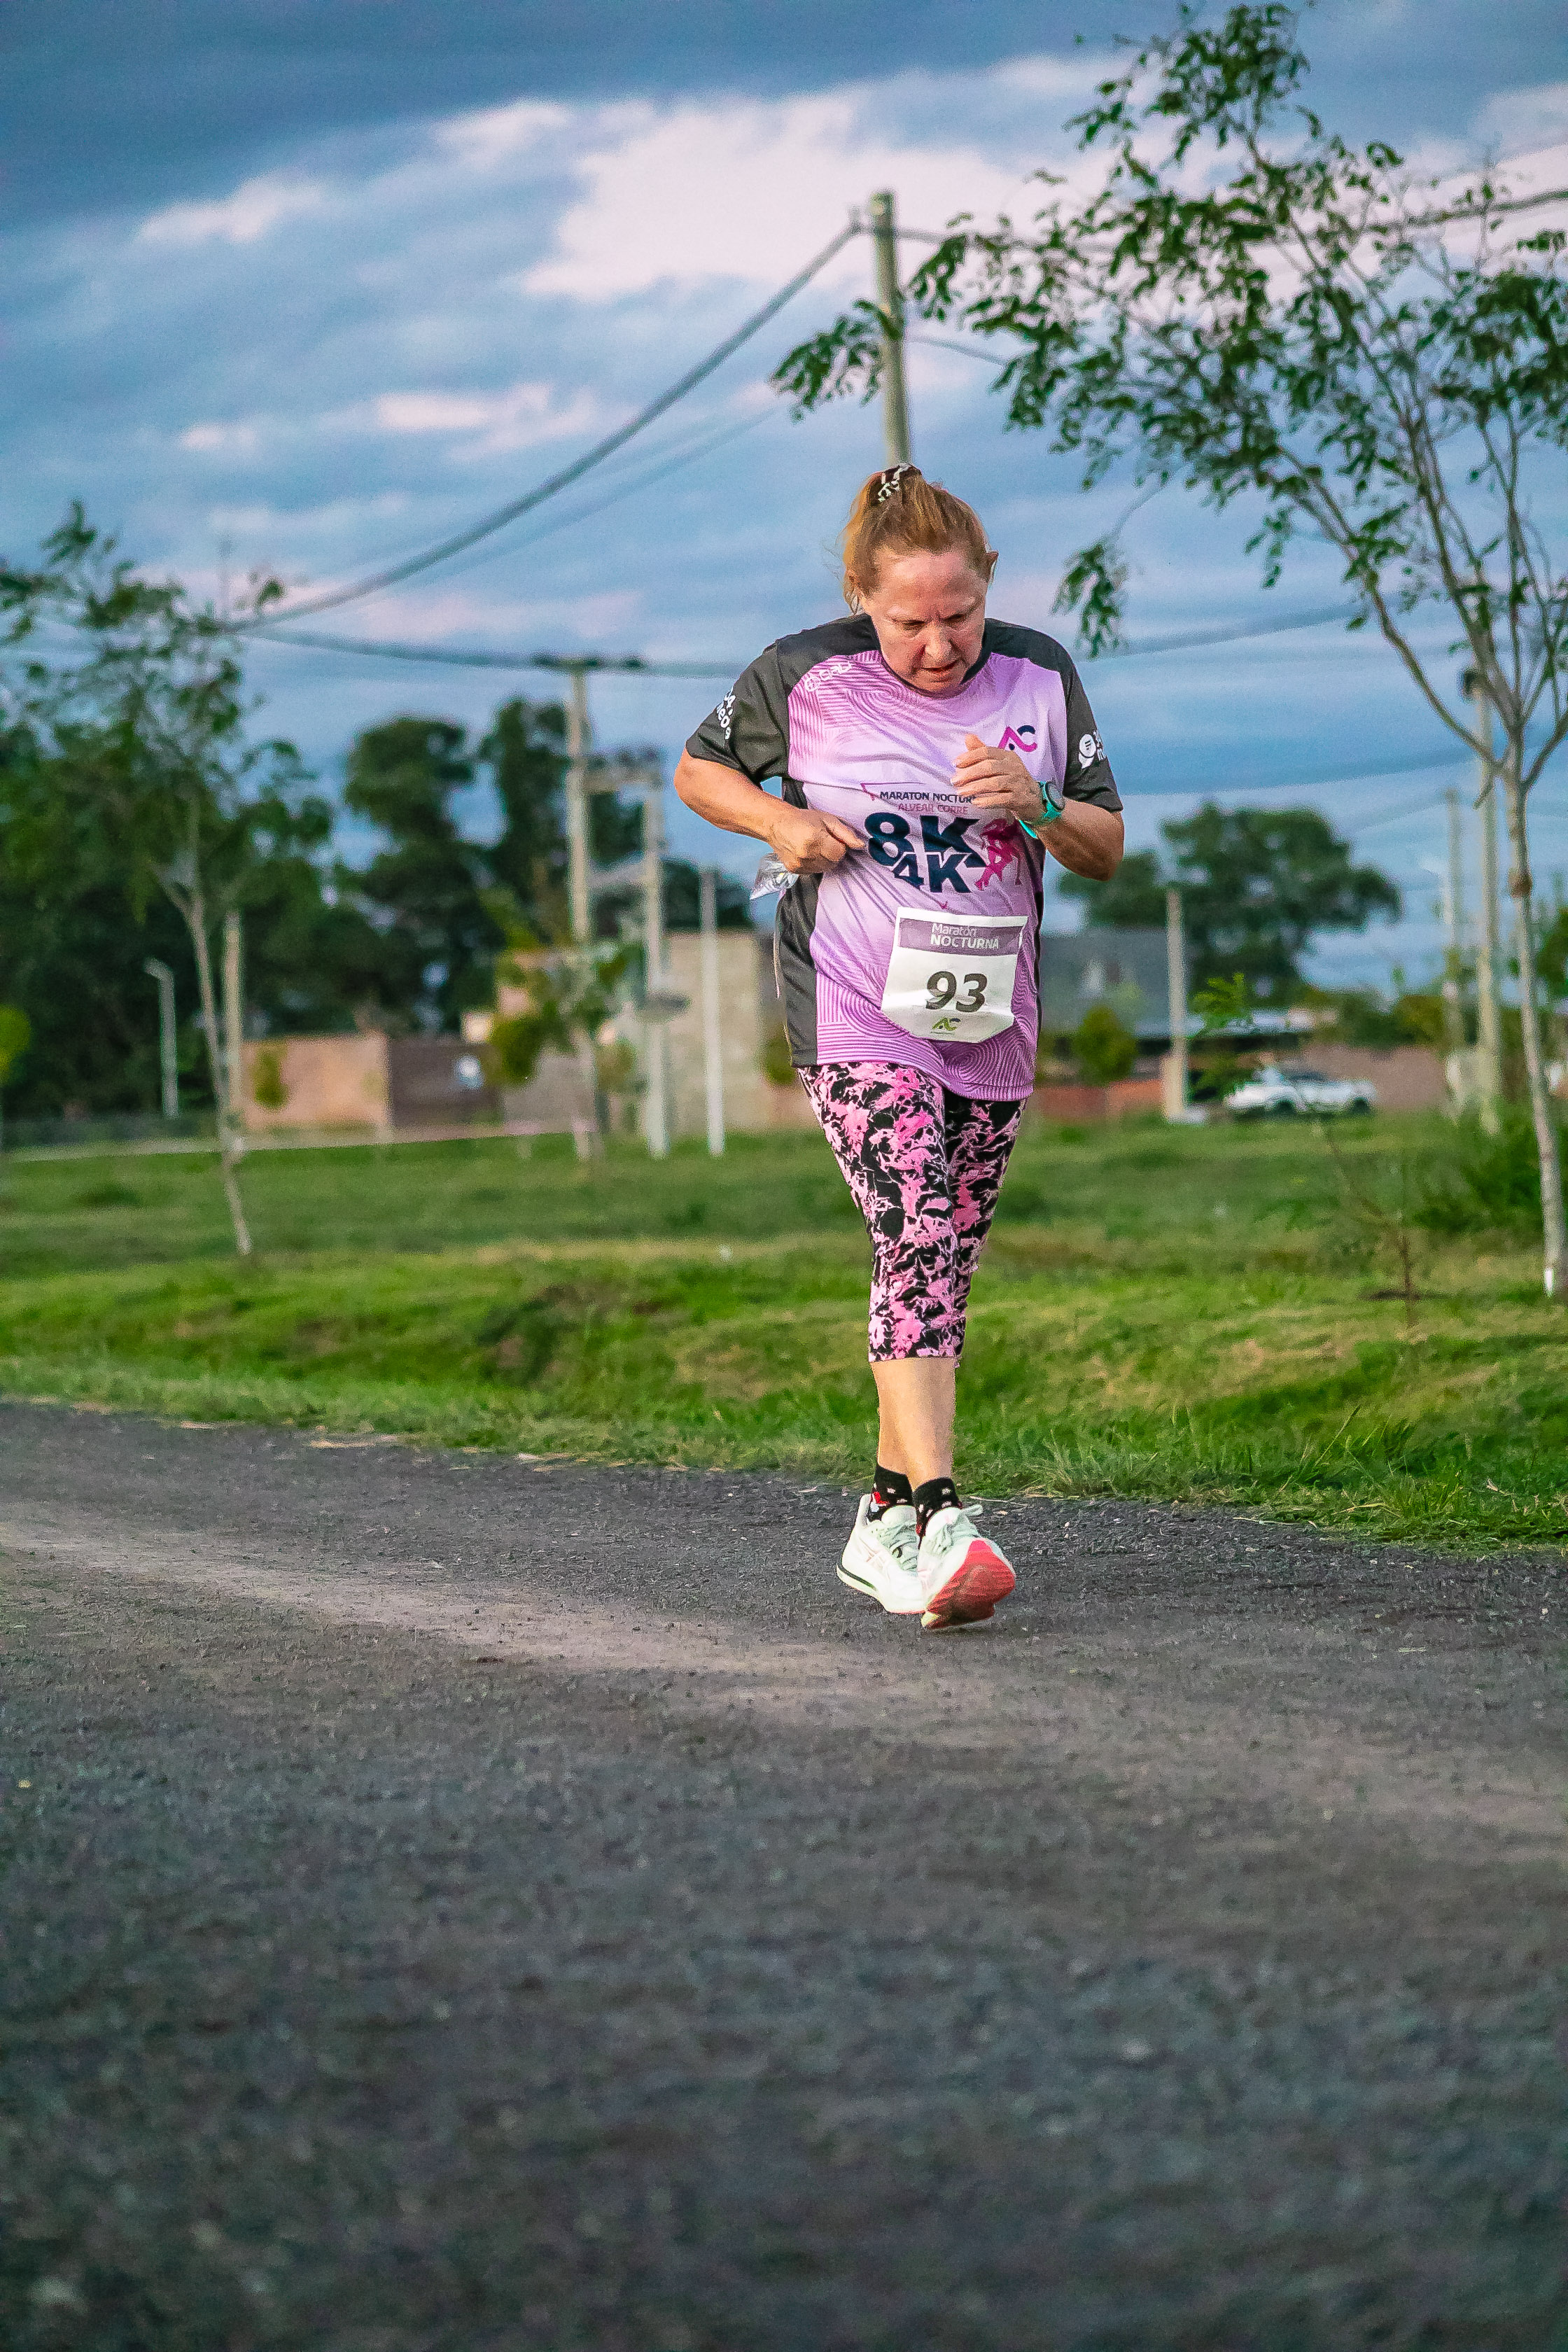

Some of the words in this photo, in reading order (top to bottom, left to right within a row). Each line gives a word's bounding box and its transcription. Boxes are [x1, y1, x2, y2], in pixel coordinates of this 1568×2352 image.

[879, 791, 930, 801] MARATON
[932, 792, 976, 804] NOCTUR
[864, 812, 986, 868] 8K
[892, 853, 972, 893] 4K
[930, 934, 1000, 950] NOCTURNA
[932, 923, 977, 937] Maratón
[925, 971, 988, 1013] 93
